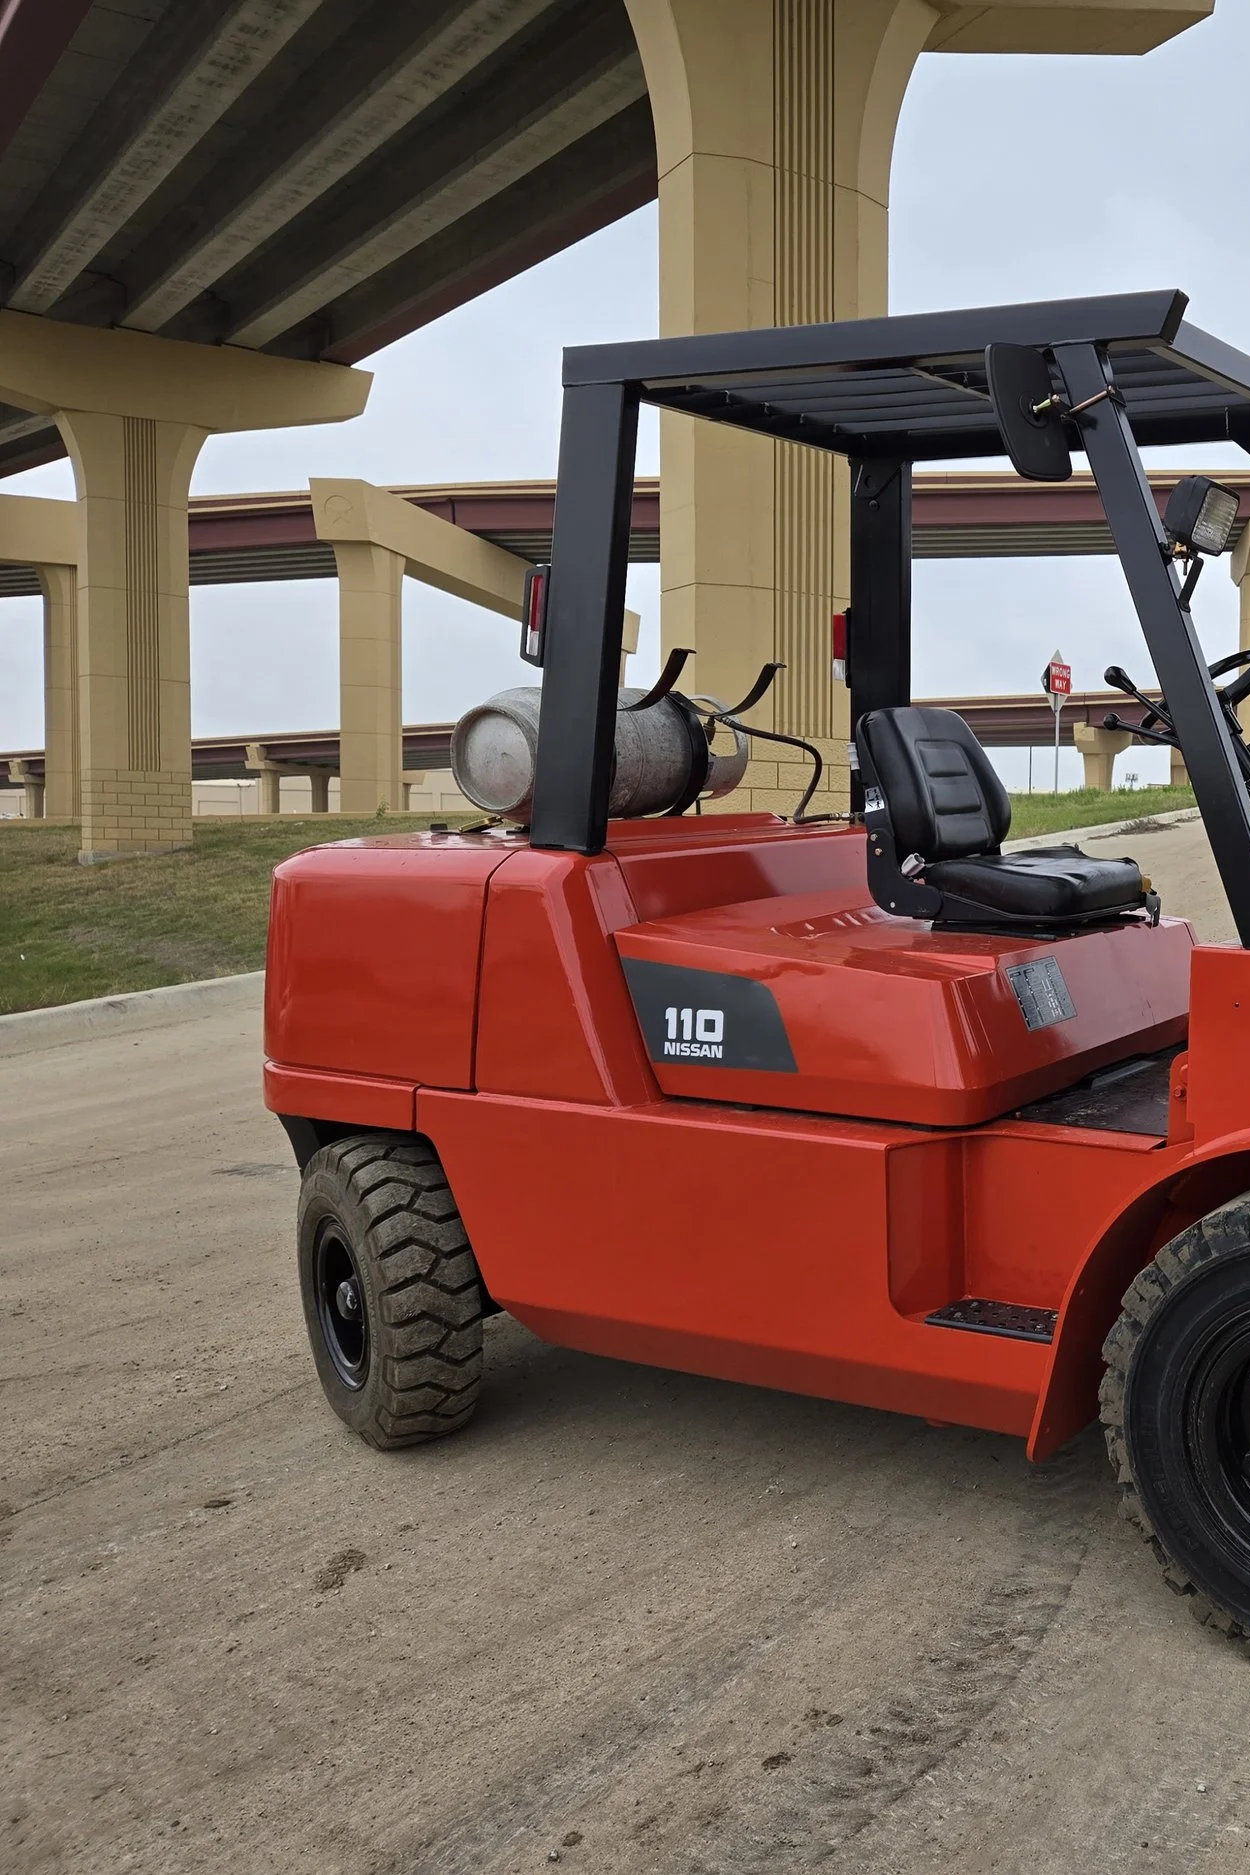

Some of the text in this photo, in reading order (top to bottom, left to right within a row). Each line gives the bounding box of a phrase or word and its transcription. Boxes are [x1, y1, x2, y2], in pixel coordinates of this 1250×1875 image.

[1051, 665, 1070, 679] WRONG
[1054, 679, 1067, 691] WAY
[665, 1007, 724, 1043] 110
[664, 1041, 723, 1059] NISSAN
